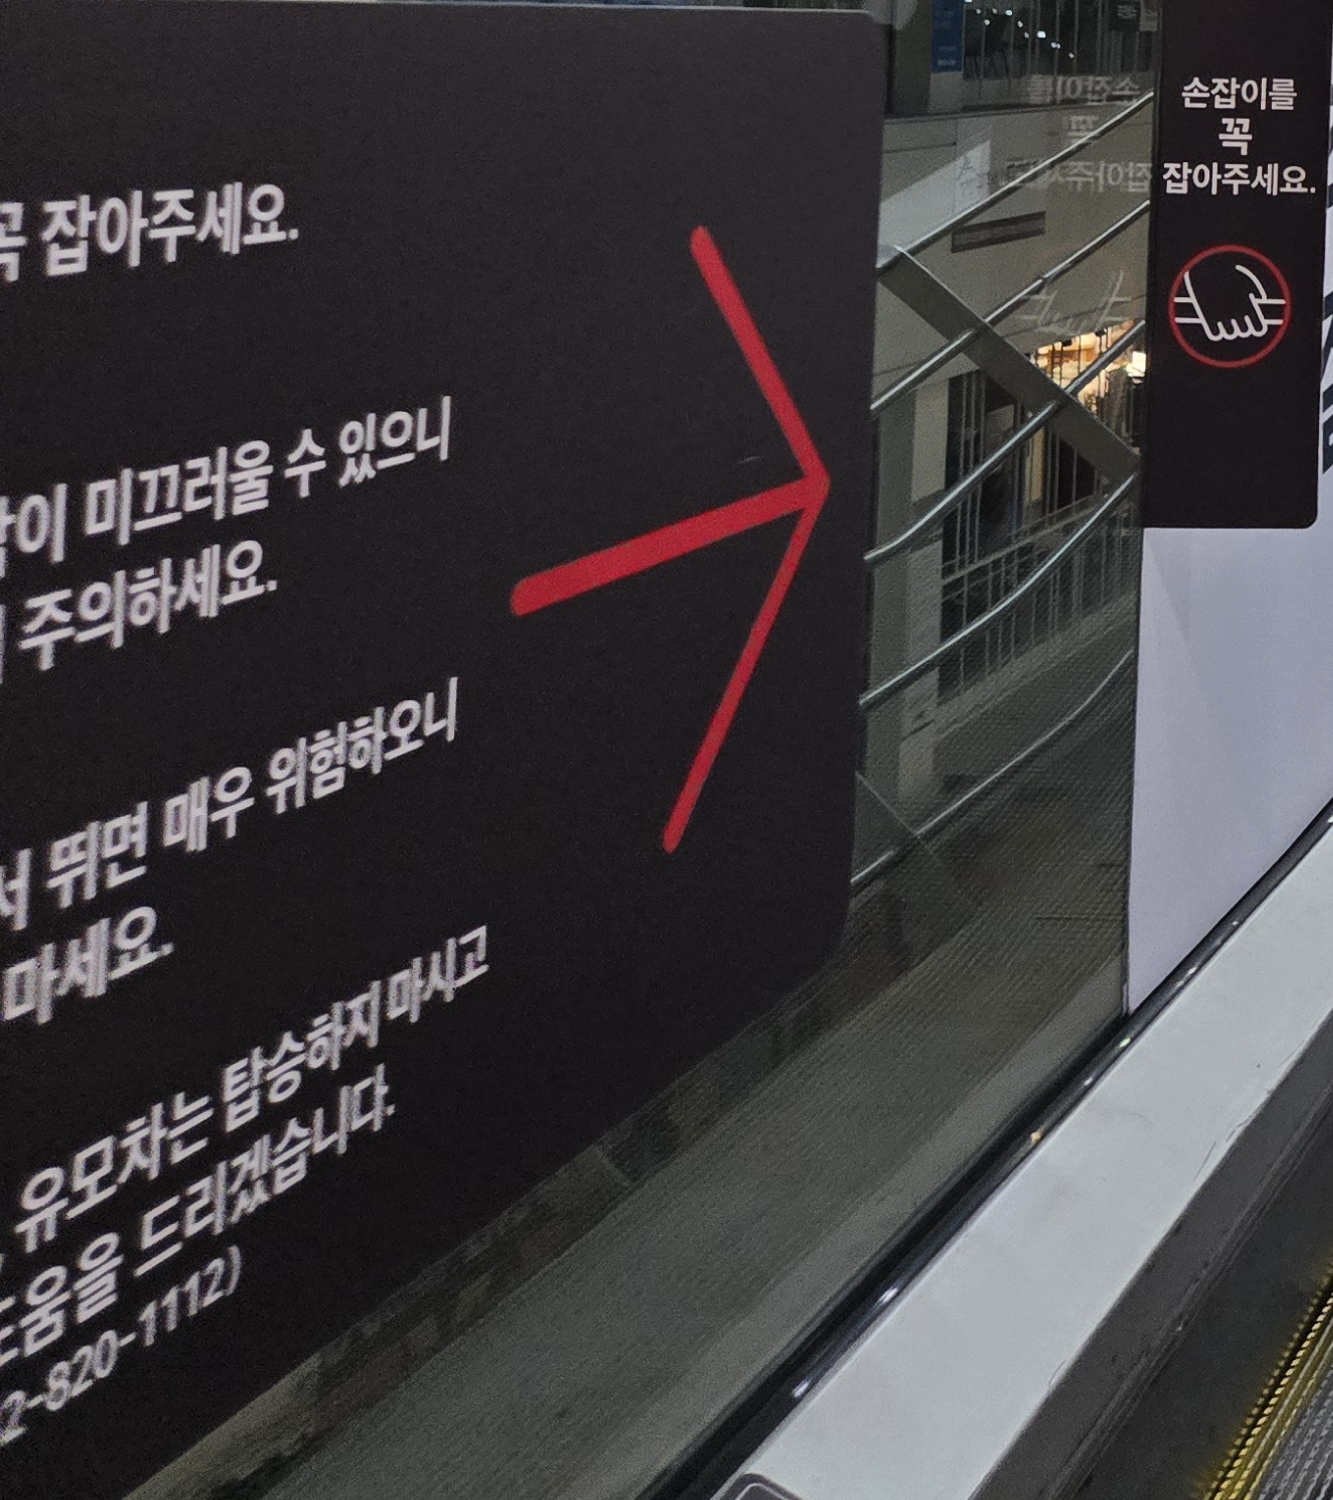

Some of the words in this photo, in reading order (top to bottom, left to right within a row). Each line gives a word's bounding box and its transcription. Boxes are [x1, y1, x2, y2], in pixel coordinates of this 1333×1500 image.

[1181, 76, 1298, 111] 손잡이를
[1218, 117, 1253, 156] 꼭
[41, 182, 300, 277] 잡아주세요.
[1162, 162, 1317, 196] 잡아주세요.
[84, 439, 274, 546] 미끄러울
[284, 428, 327, 498] 수
[338, 395, 452, 487] 있으니
[18, 539, 278, 671] 주의하세요.
[47, 802, 148, 908] 뛰면
[163, 765, 255, 853] 매우
[266, 677, 460, 814] 위험하오니
[2, 904, 174, 1025] 마세요.
[14, 1091, 210, 1253] 유모차는
[221, 980, 381, 1130] 탑승하지
[387, 925, 488, 1023] 마시고
[133, 1063, 396, 1276] 드리겠습니다.
